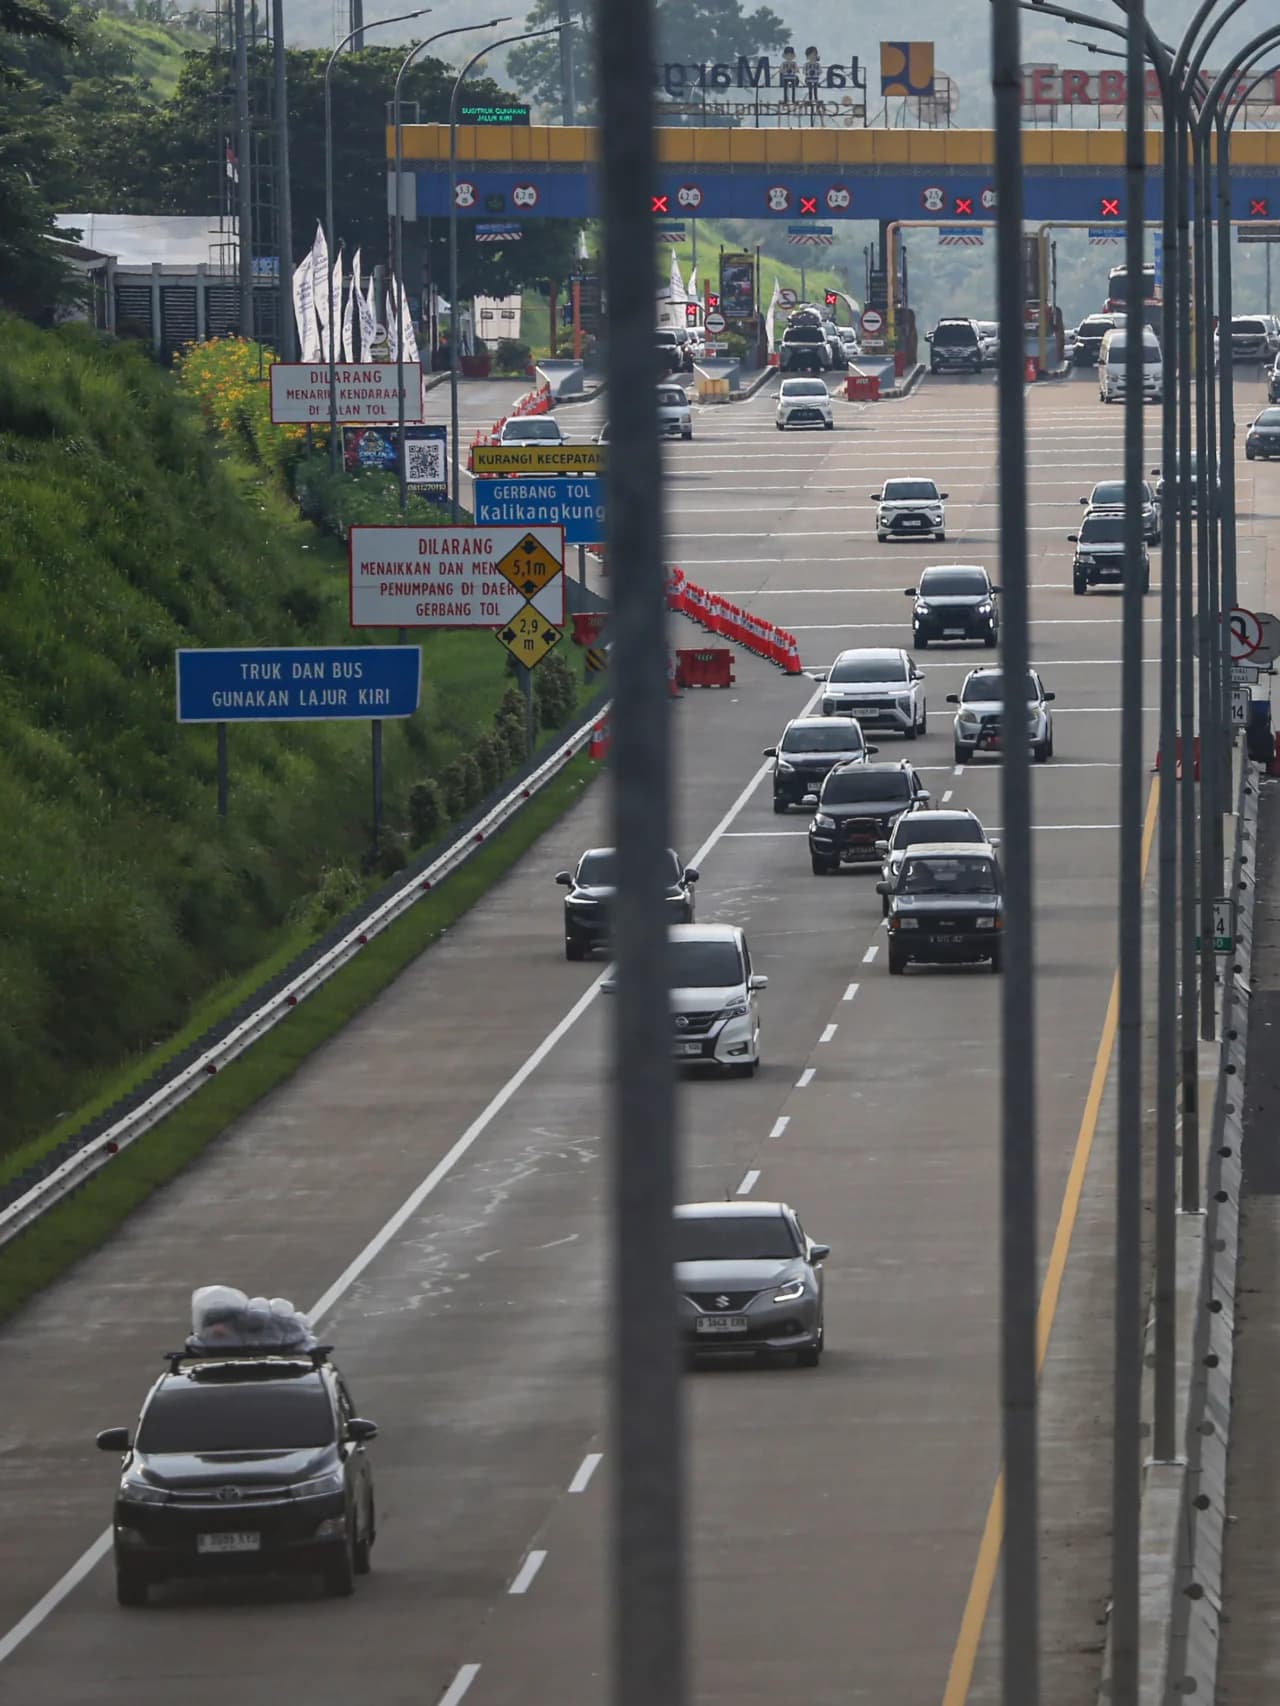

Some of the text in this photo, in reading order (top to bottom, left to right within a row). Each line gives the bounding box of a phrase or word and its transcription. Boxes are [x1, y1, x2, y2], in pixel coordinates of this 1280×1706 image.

[310, 370, 382, 384] DILARANG
[309, 404, 319, 415] DI
[367, 404, 387, 415] TOL
[478, 453, 533, 465] KURANGI
[493, 484, 592, 500] GERBANG TOL
[480, 502, 606, 524] Kalikangkung
[418, 538, 493, 556] DILARANG
[360, 561, 431, 576] MENAIKKAN
[439, 561, 463, 576] DAN
[380, 582, 453, 597] PENUMPANG
[461, 582, 474, 596] DI
[416, 601, 501, 617] GERBANG TOL
[519, 618, 539, 635] 2,9
[523, 639, 534, 651] m
[240, 661, 363, 680] TRUK DAN BUS
[212, 688, 390, 708] GUNAKAN LAJUR KIRI
